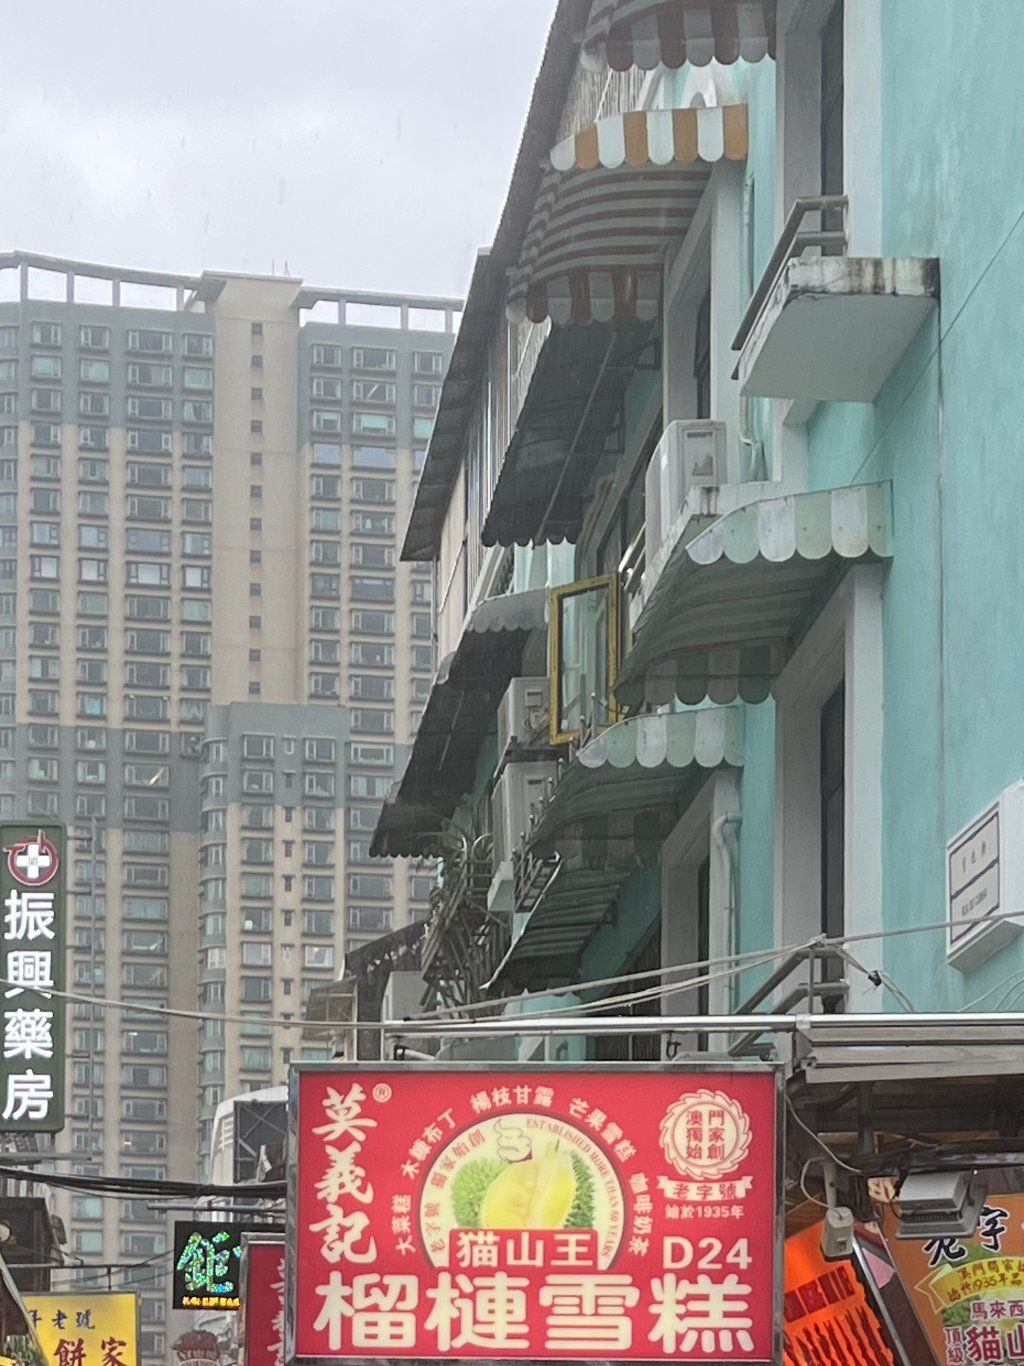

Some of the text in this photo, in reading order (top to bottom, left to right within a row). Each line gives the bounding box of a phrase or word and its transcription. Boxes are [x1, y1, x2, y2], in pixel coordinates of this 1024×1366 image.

[2, 889, 55, 1121] 振興藥房
[568, 1097, 637, 1162] 芒果雪糕
[309, 1082, 378, 1265] 莫義記
[629, 1172, 654, 1258] 咖啡奶茶
[662, 1236, 753, 1270] D24
[312, 1270, 756, 1354] 榴槤雪糕
